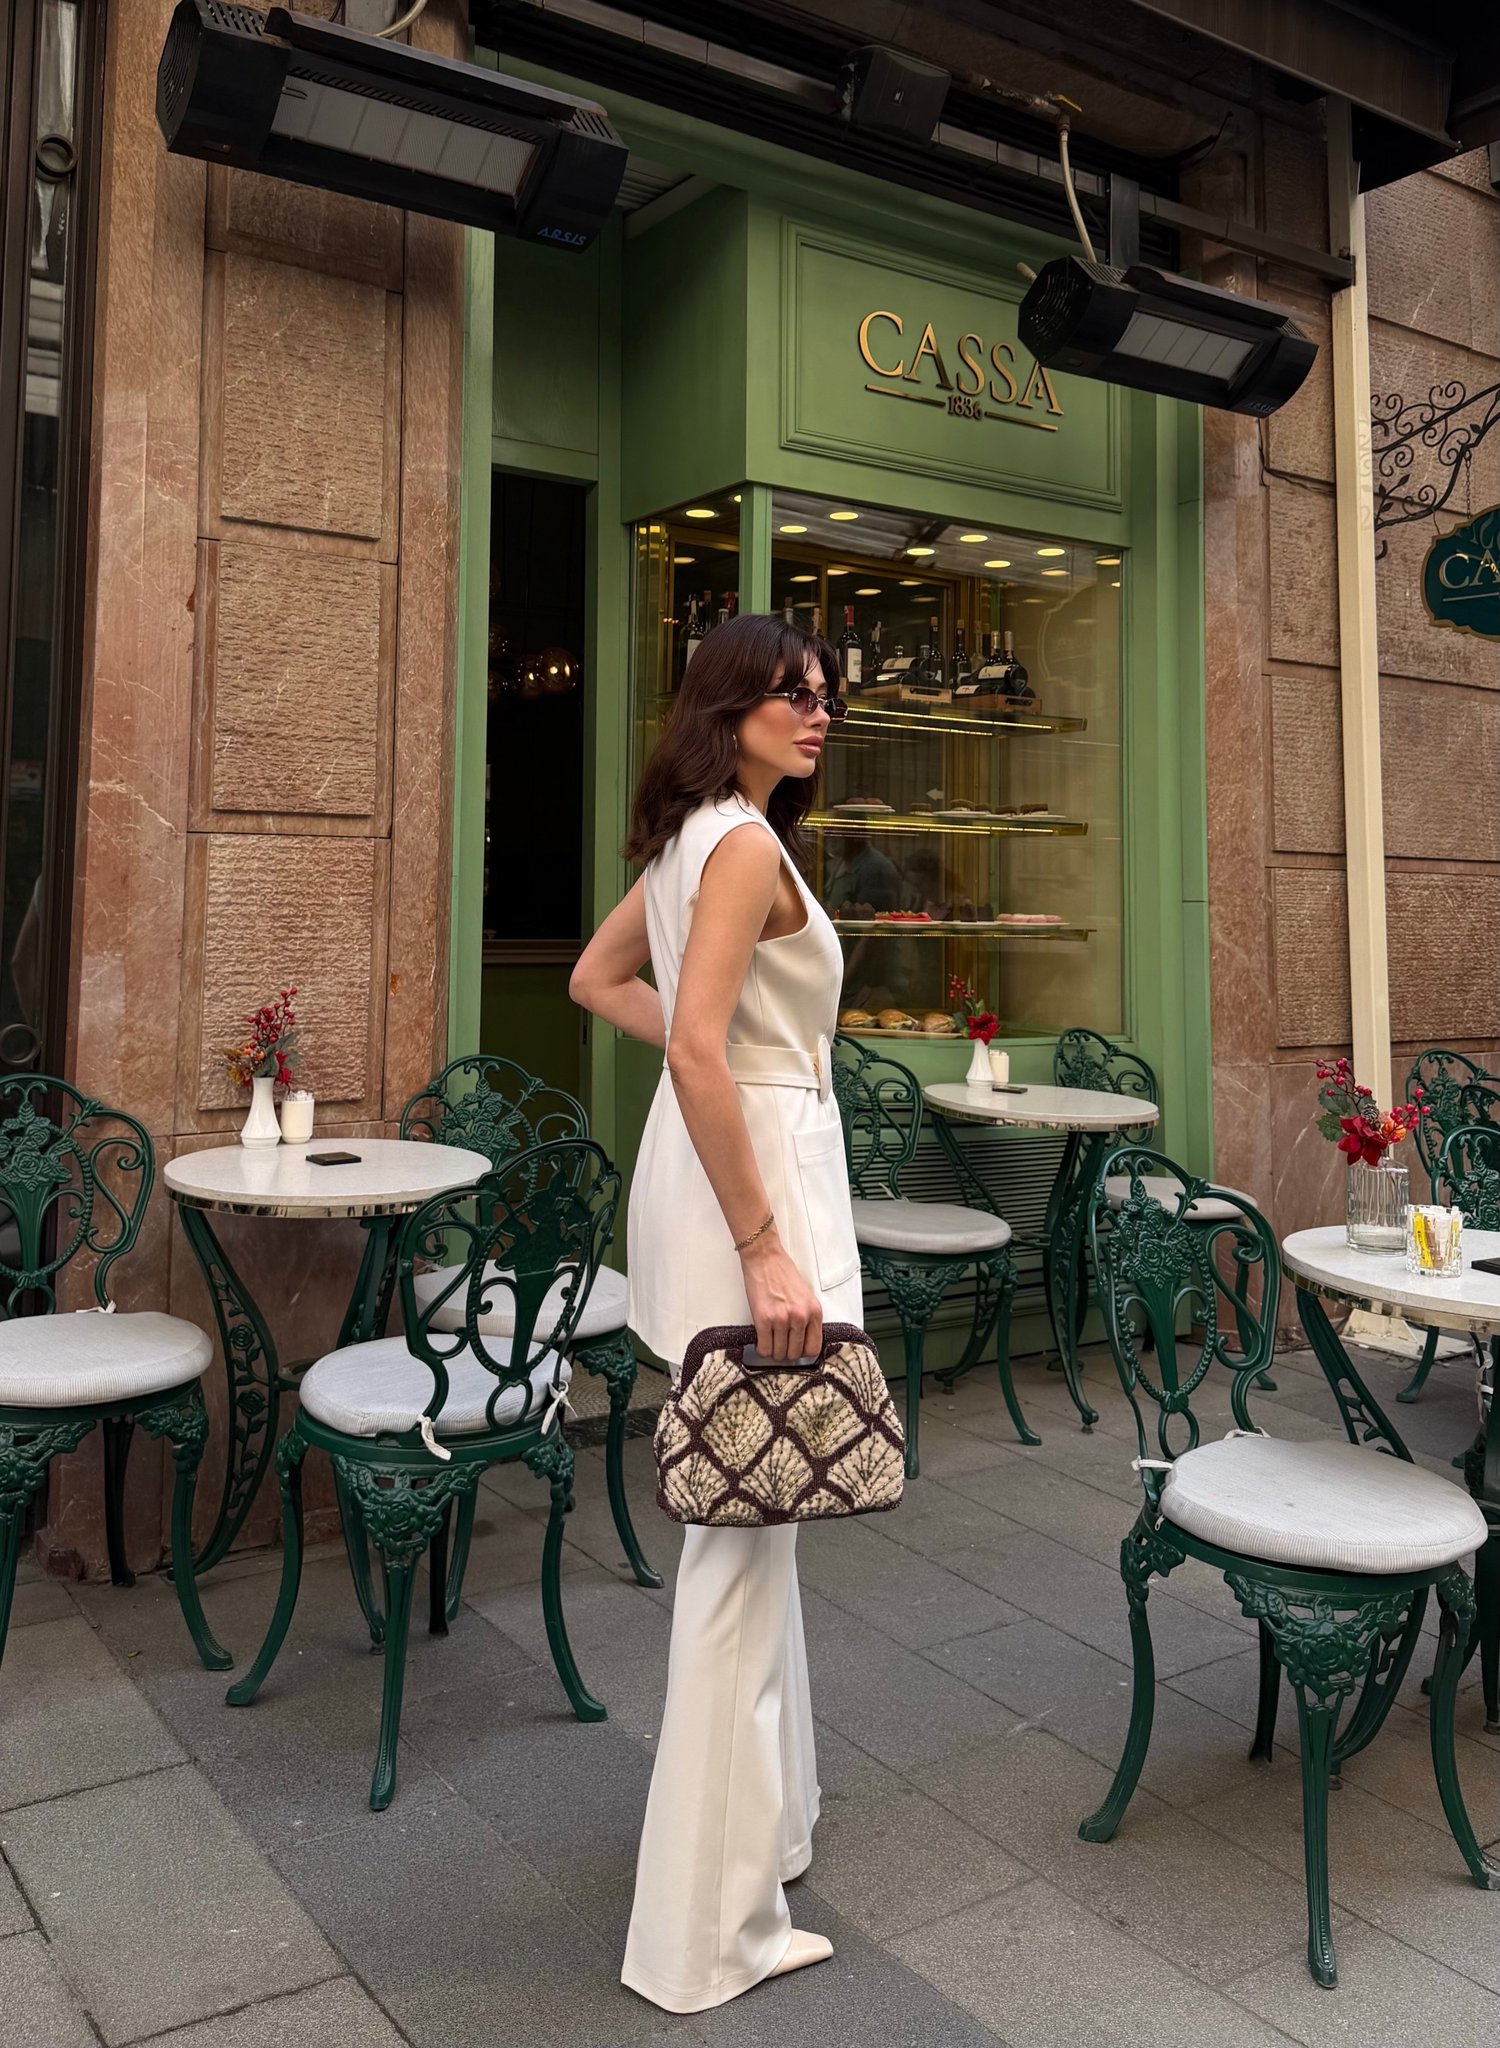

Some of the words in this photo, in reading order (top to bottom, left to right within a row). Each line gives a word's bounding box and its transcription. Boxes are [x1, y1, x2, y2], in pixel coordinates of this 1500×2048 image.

[537, 227, 586, 245] ARSIS
[858, 310, 1064, 415] CASSA
[947, 395, 984, 420] 1836
